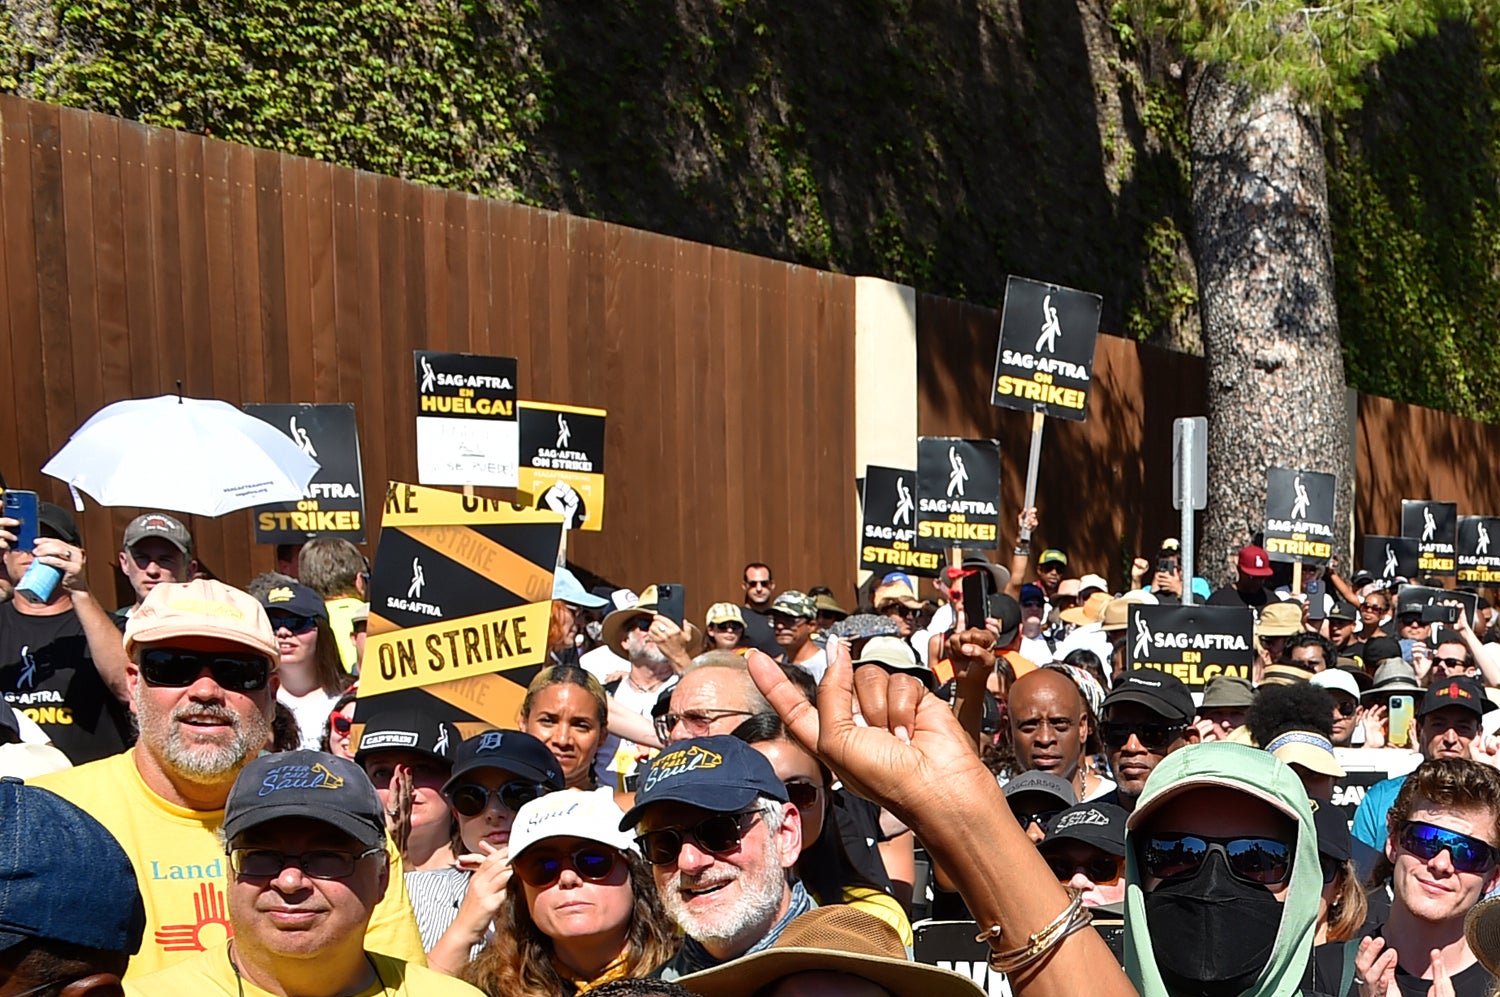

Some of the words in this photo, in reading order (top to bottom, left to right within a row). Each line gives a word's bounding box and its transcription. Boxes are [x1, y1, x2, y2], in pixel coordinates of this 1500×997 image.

[1033, 371, 1053, 384] ON
[459, 388, 474, 397] EN
[997, 375, 1086, 409] STRIKE!
[421, 396, 513, 416] HUELGA!
[532, 457, 550, 467] ON
[552, 459, 592, 472] STRIKE!
[297, 500, 318, 511] ON
[258, 511, 360, 531] STRIKE!
[948, 513, 965, 523] ON
[918, 521, 996, 541] STRIKE!
[1292, 533, 1306, 541] ON
[892, 541, 909, 550] ON
[1266, 538, 1331, 558] STRIKE!
[863, 546, 938, 569] STRIKE!
[1418, 558, 1454, 570] RIKE!
[378, 638, 418, 681] ON
[425, 616, 532, 672] STRIKE
[1182, 651, 1201, 663] EN
[28, 707, 73, 724] ONG
[366, 735, 412, 745] CAPTAIN
[643, 753, 703, 793] Saul
[258, 773, 325, 797] Saul
[151, 858, 222, 880] Land
